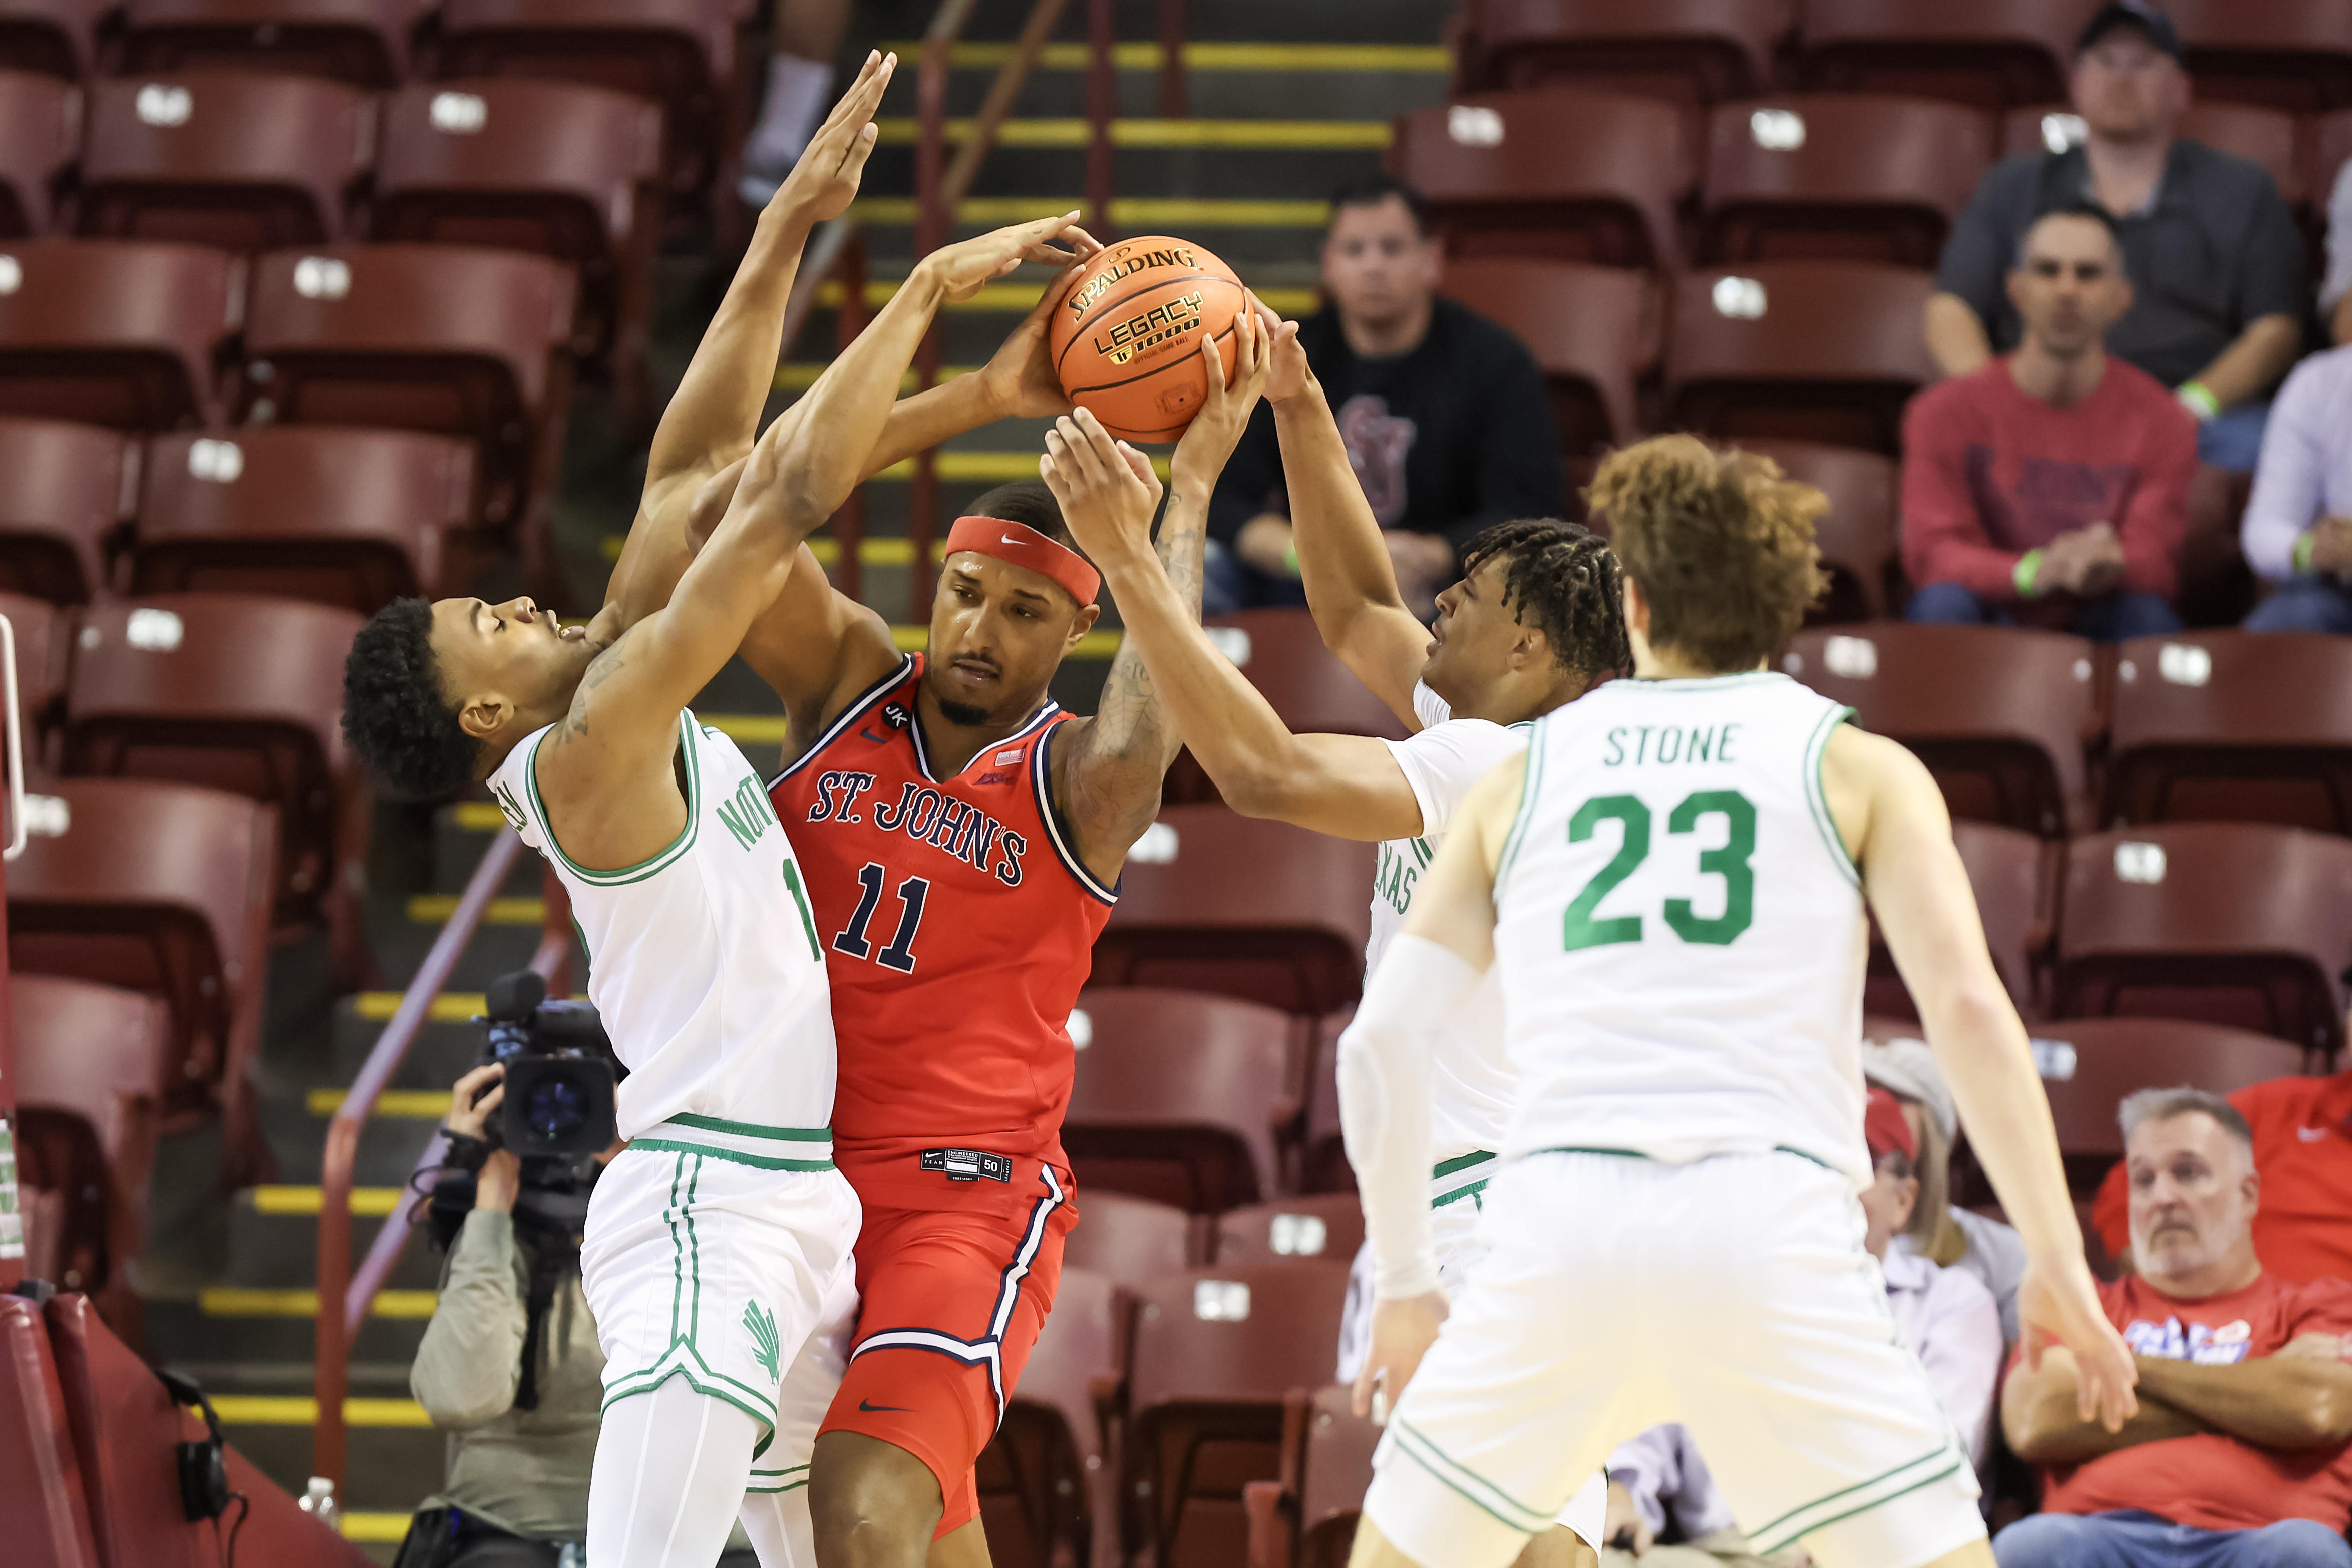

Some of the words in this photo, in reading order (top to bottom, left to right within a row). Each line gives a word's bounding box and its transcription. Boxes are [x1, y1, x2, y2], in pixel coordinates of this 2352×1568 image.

[1068, 247, 1197, 323] SPALDING
[1094, 291, 1204, 356] LEGACY
[1134, 316, 1200, 353] 1000
[886, 706, 908, 727] JK
[1603, 723, 1742, 766] STONE
[806, 770, 877, 824] ST.
[874, 782, 1028, 888] JOHN'S
[1375, 841, 1417, 915] XAS
[1564, 790, 1756, 952] 23
[832, 861, 931, 974] 11
[984, 1159, 998, 1172] 50
